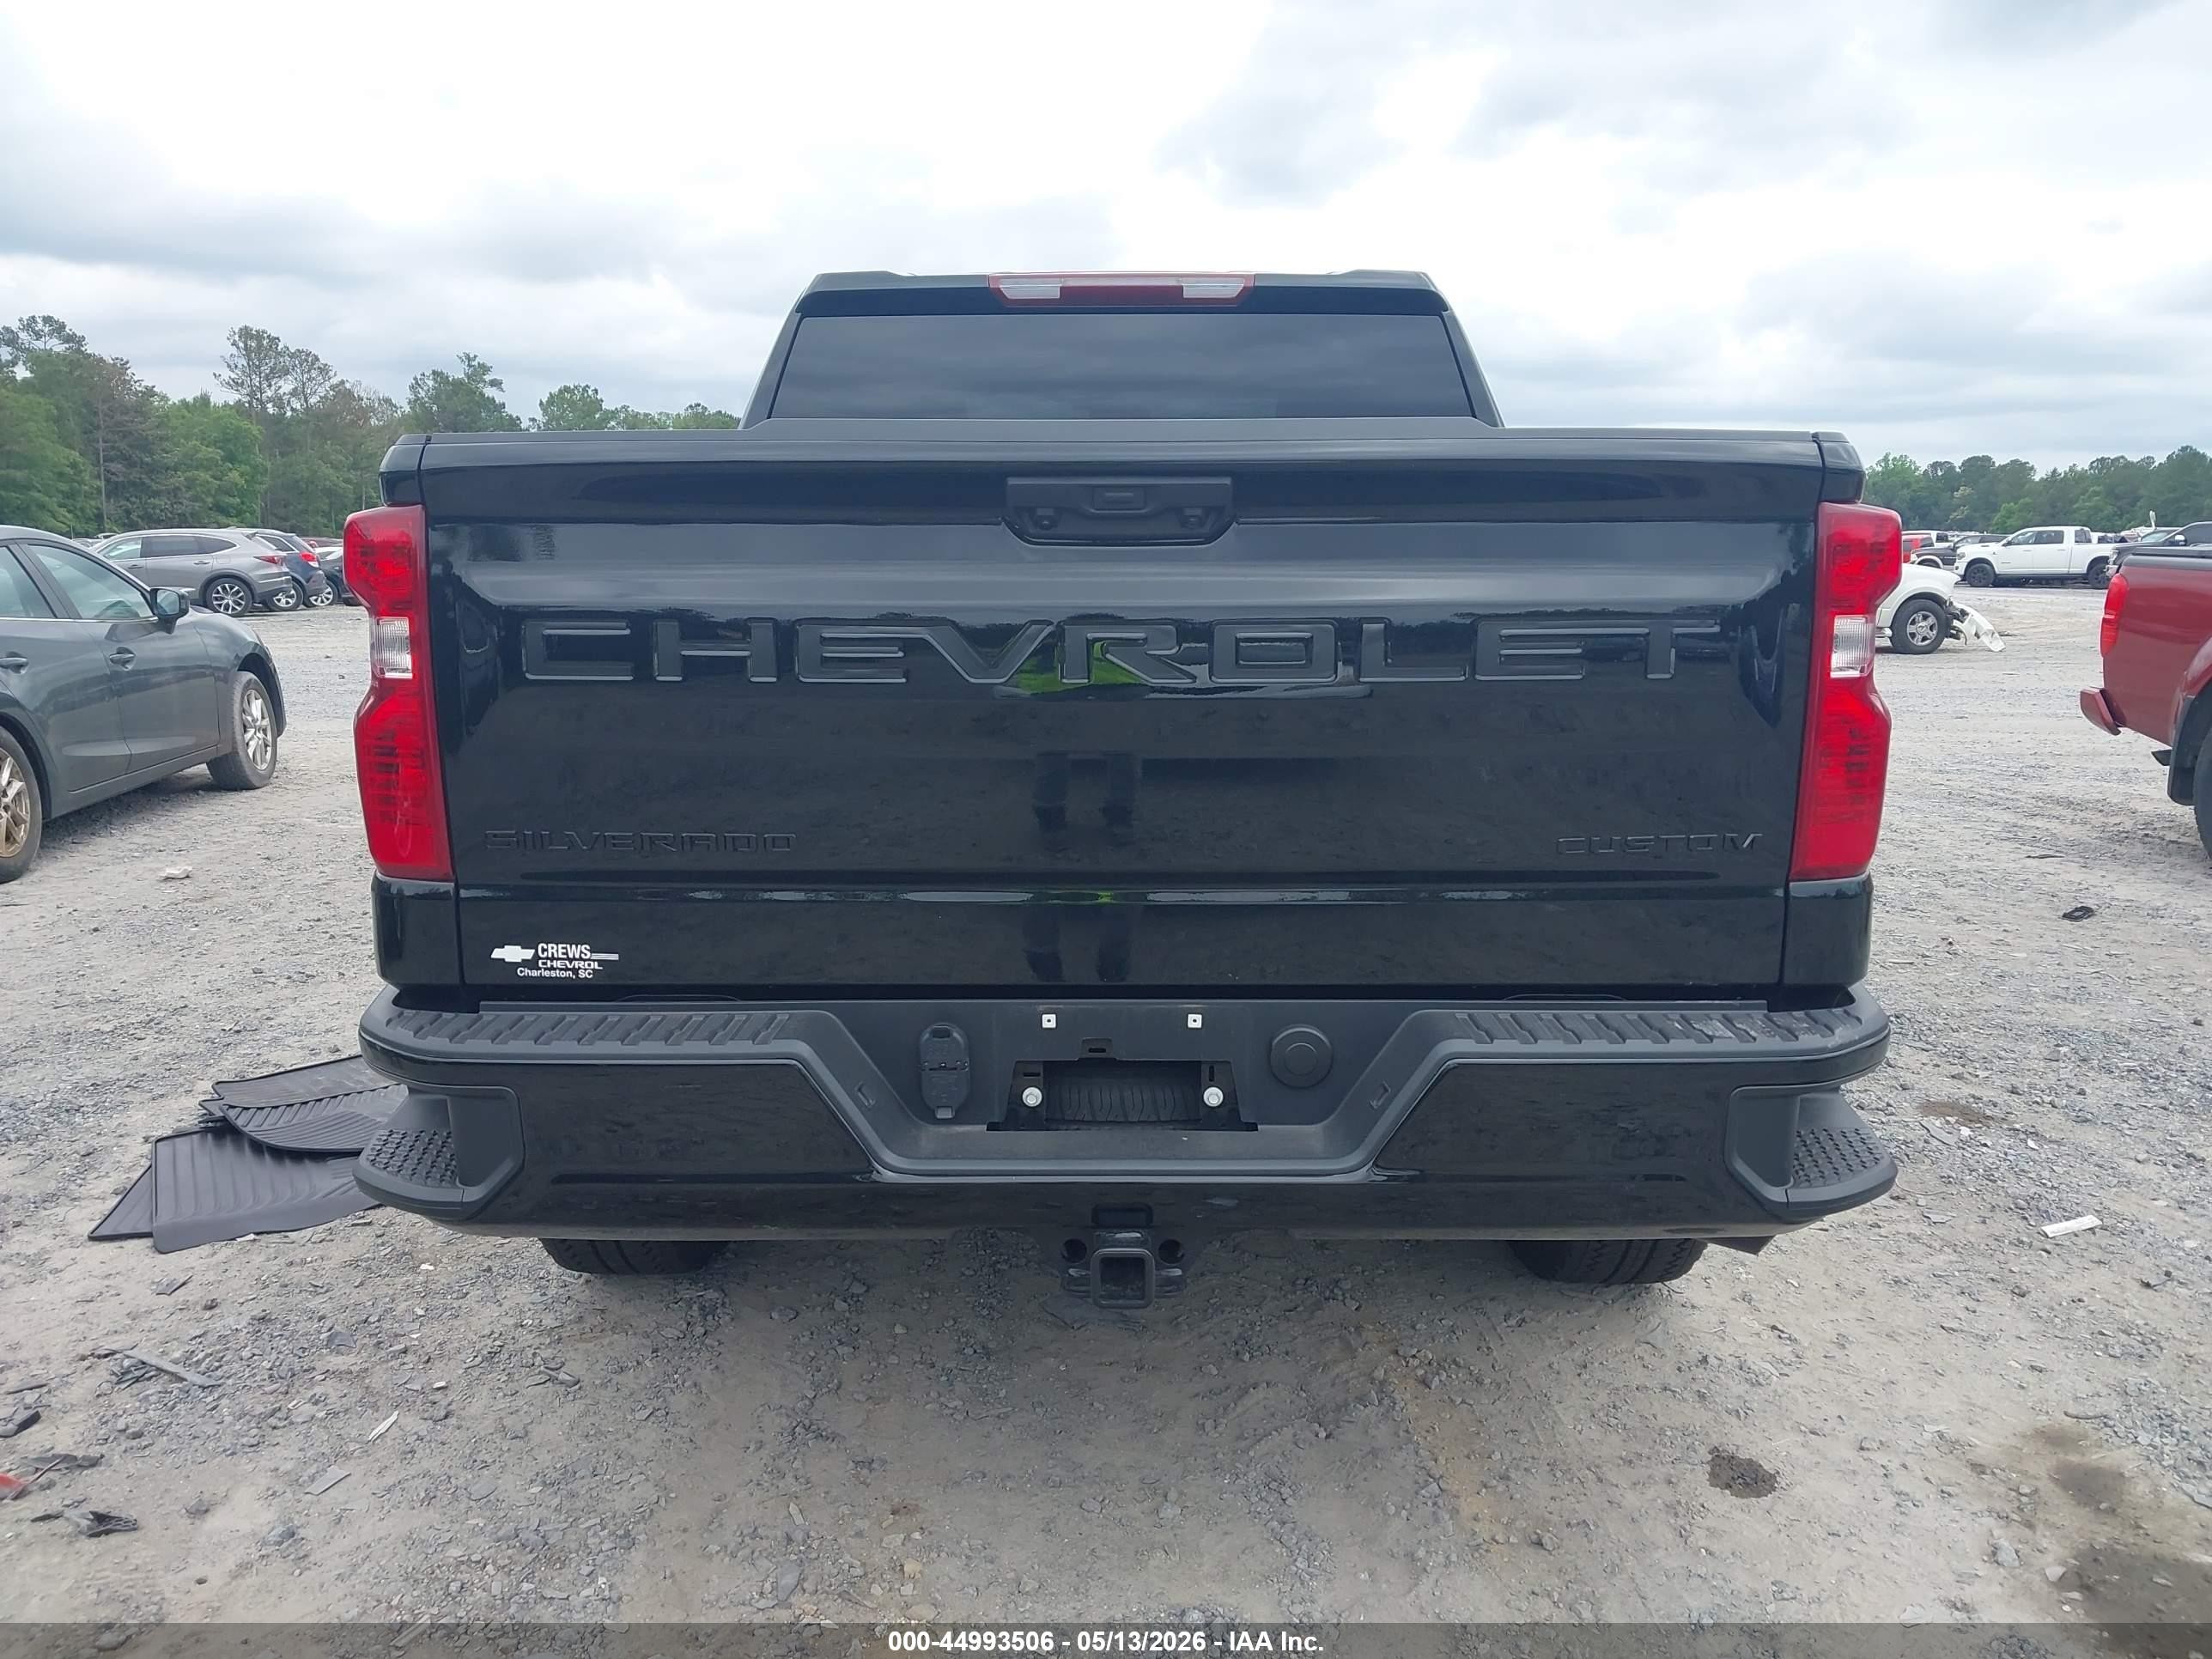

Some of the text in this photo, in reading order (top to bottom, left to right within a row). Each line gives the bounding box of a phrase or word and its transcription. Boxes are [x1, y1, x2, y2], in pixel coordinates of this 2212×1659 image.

[520, 618, 1721, 684] CHEVROLET
[484, 830, 797, 852] SILVERADO
[1556, 833, 1763, 854] CUSTOM
[538, 943, 591, 959] CREWS
[516, 967, 593, 979] Charleston, SC
